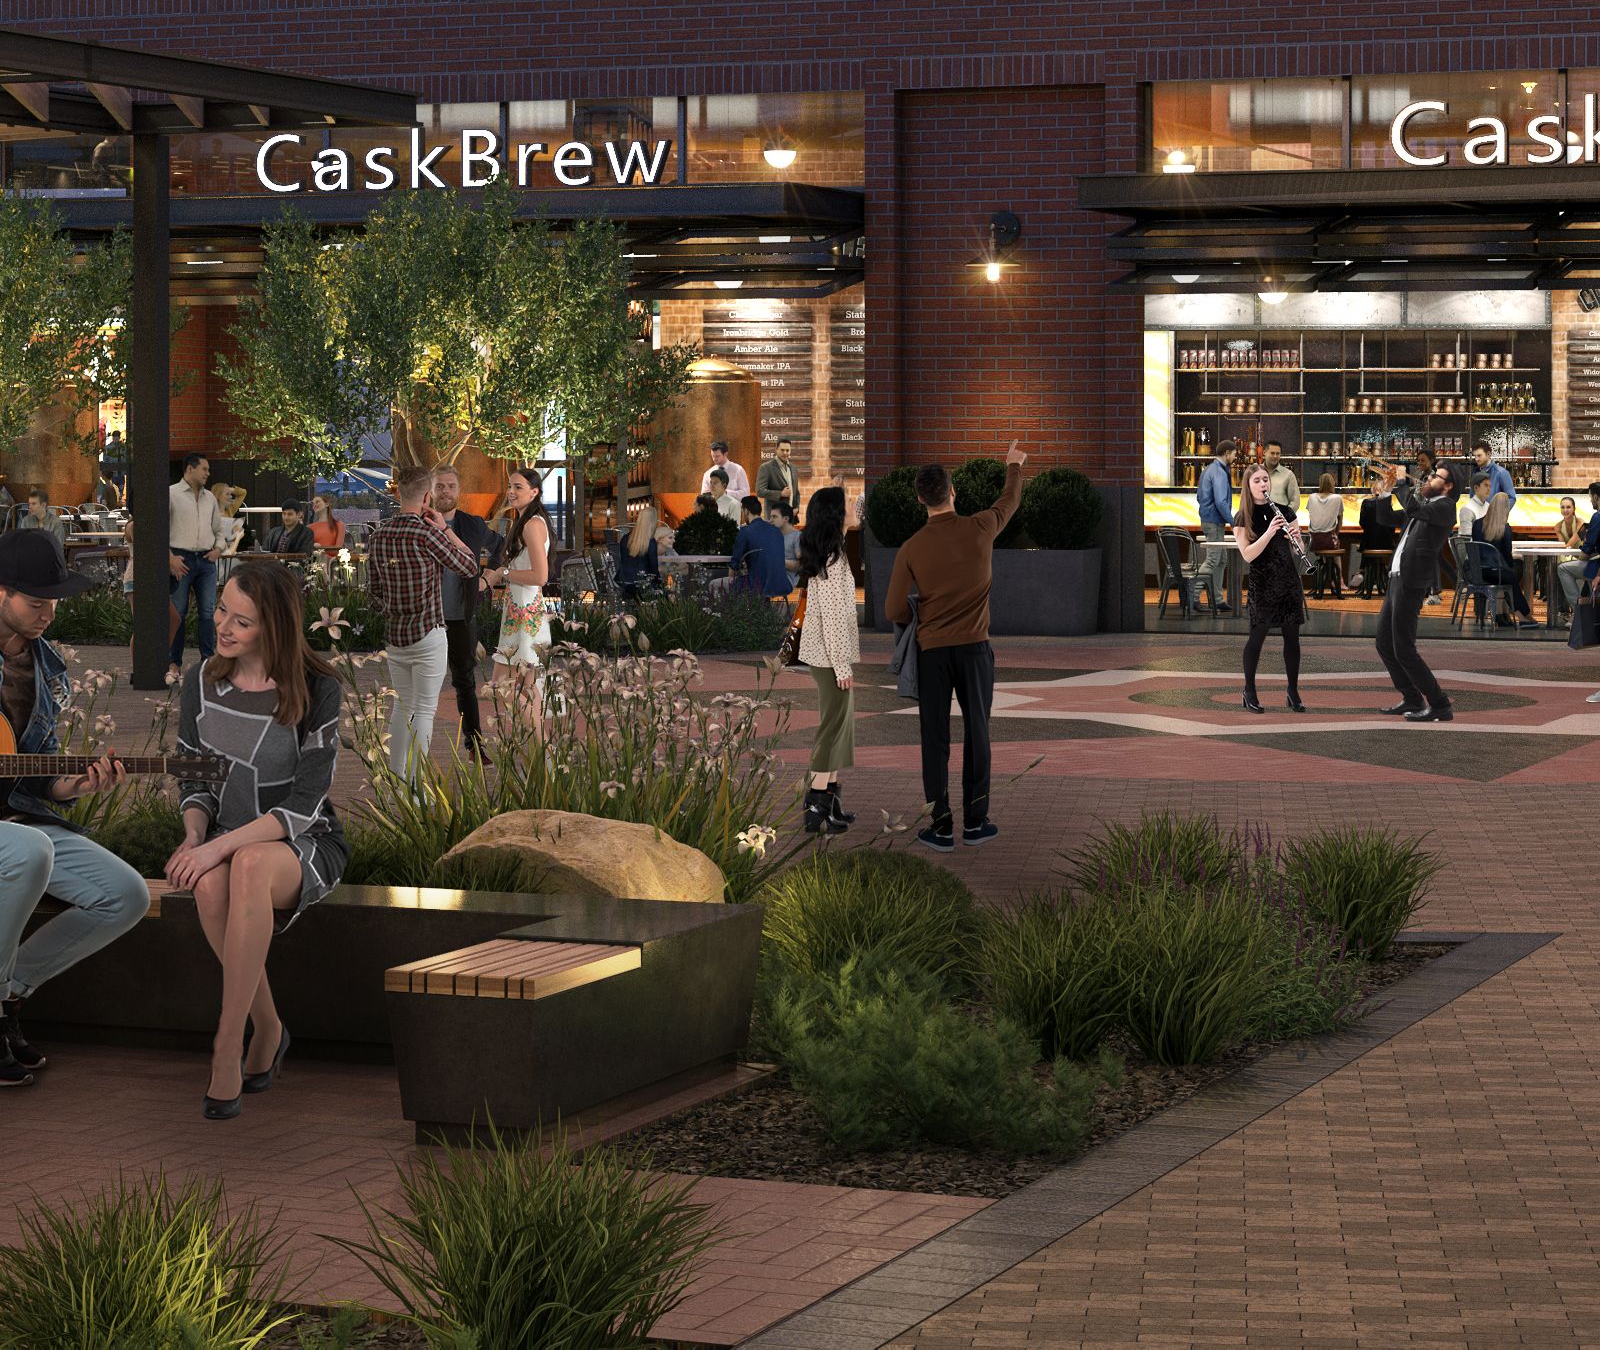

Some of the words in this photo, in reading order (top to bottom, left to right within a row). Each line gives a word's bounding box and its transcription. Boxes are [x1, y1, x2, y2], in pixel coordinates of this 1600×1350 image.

[255, 125, 670, 192] CaskBrew
[734, 345, 762, 353] Amber
[764, 345, 778, 353] Ale
